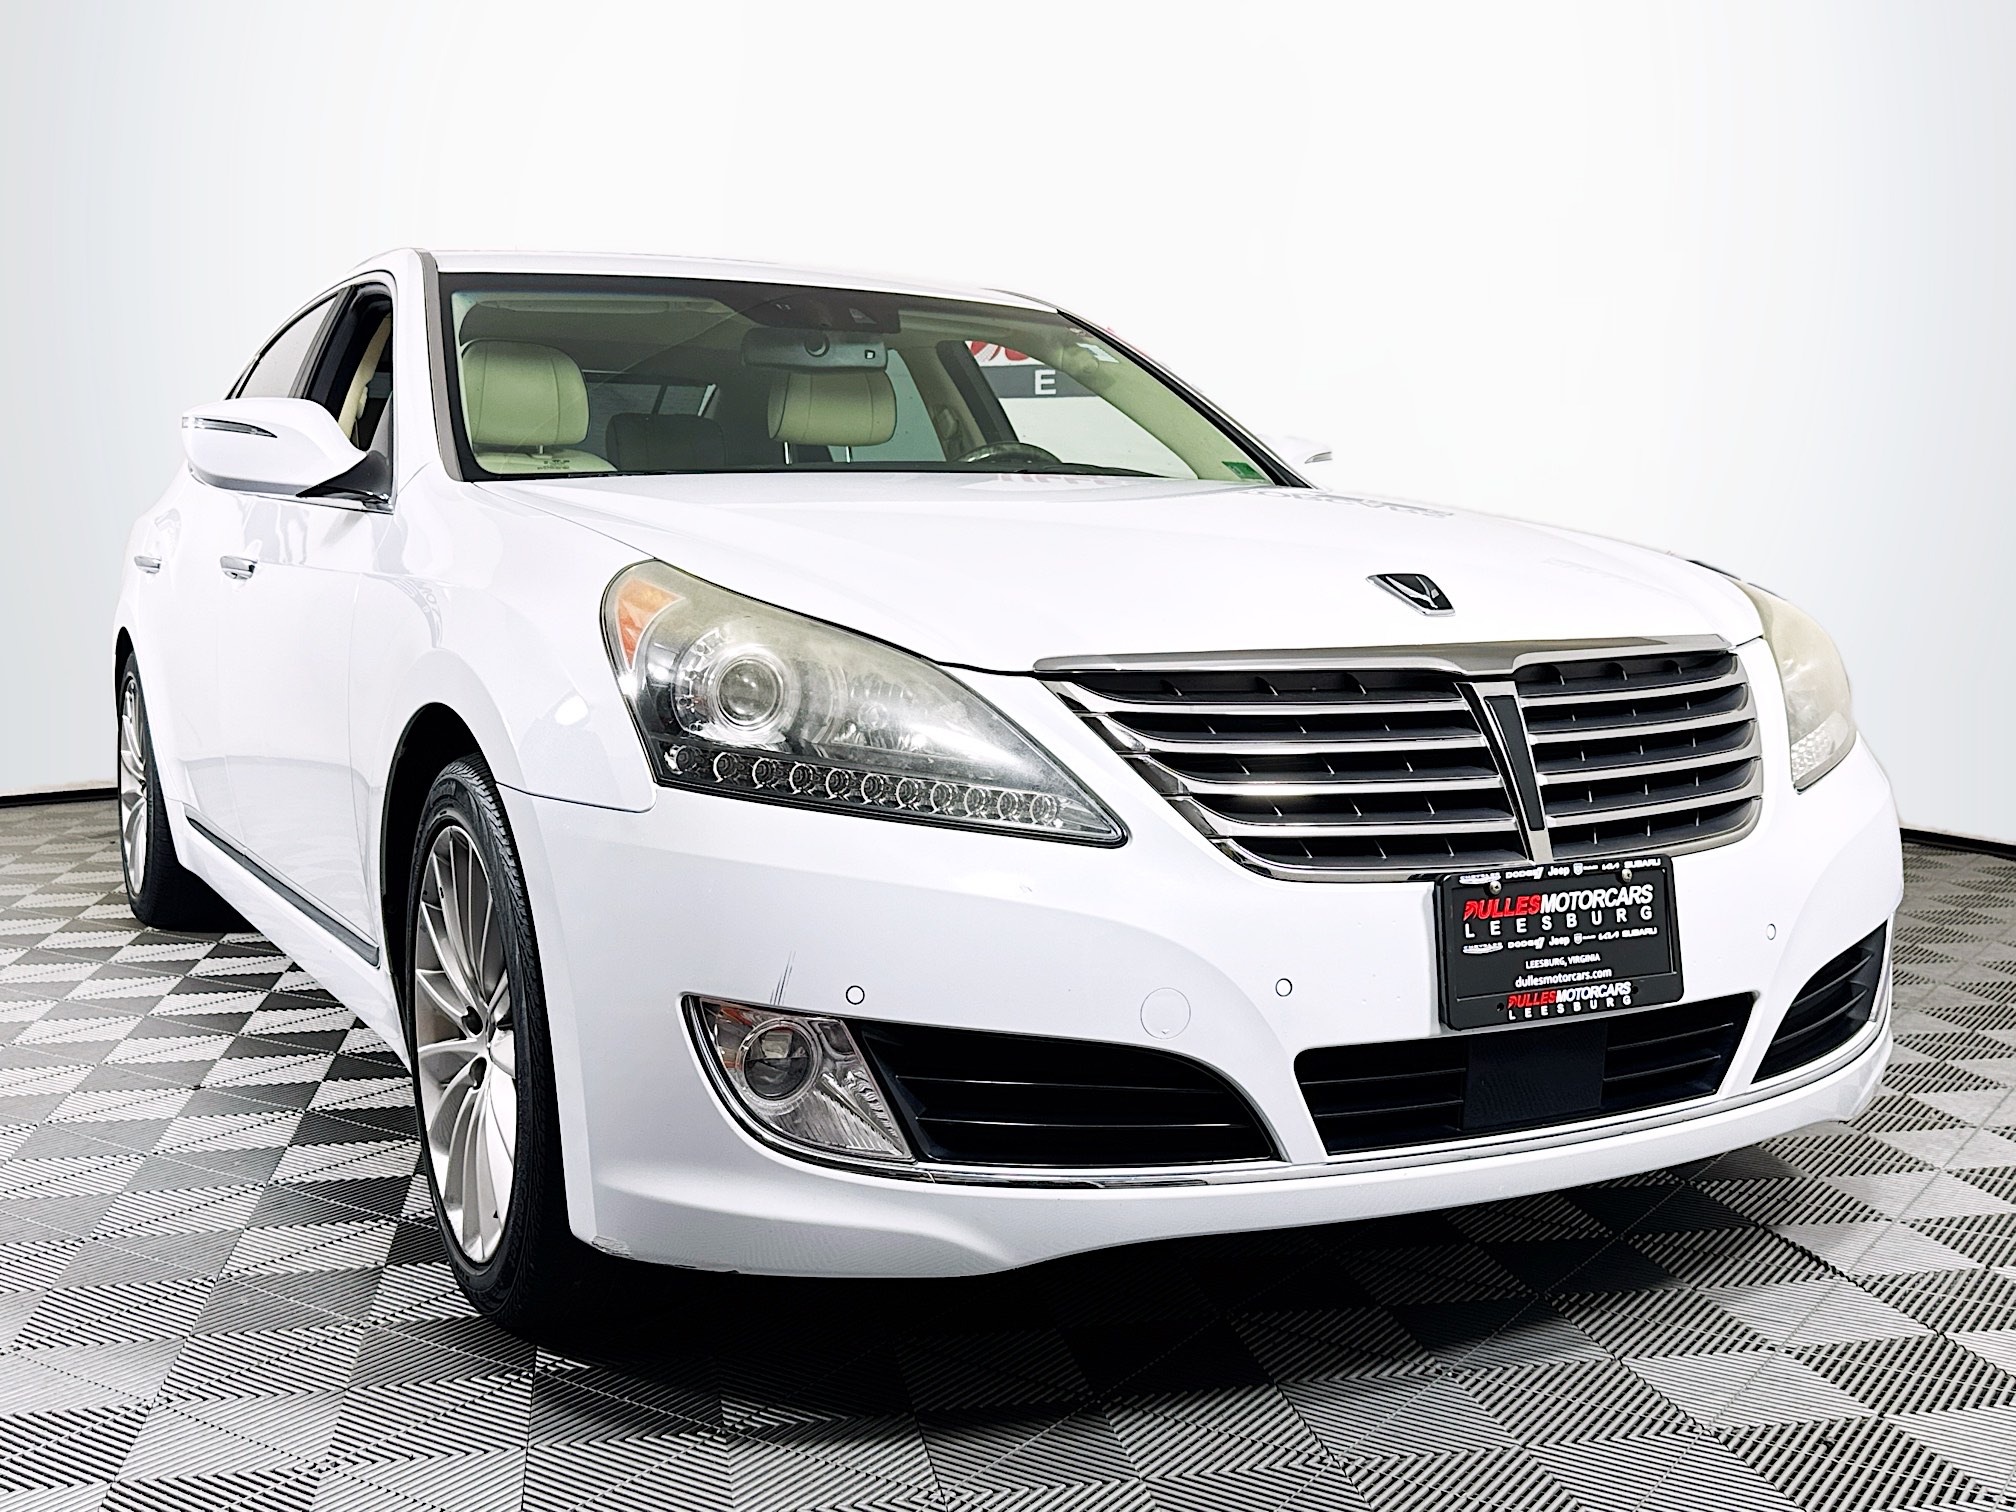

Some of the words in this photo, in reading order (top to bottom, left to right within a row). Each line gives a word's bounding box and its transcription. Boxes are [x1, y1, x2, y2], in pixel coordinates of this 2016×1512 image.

[1034, 369, 1057, 395] E
[1548, 866, 1570, 877] Jeep
[1548, 936, 1570, 947] Jeep
[1525, 959, 1567, 969] LEESBURG,
[1567, 953, 1601, 965] VIRGINIA
[1515, 969, 1612, 988] dullesmotorcars.com
